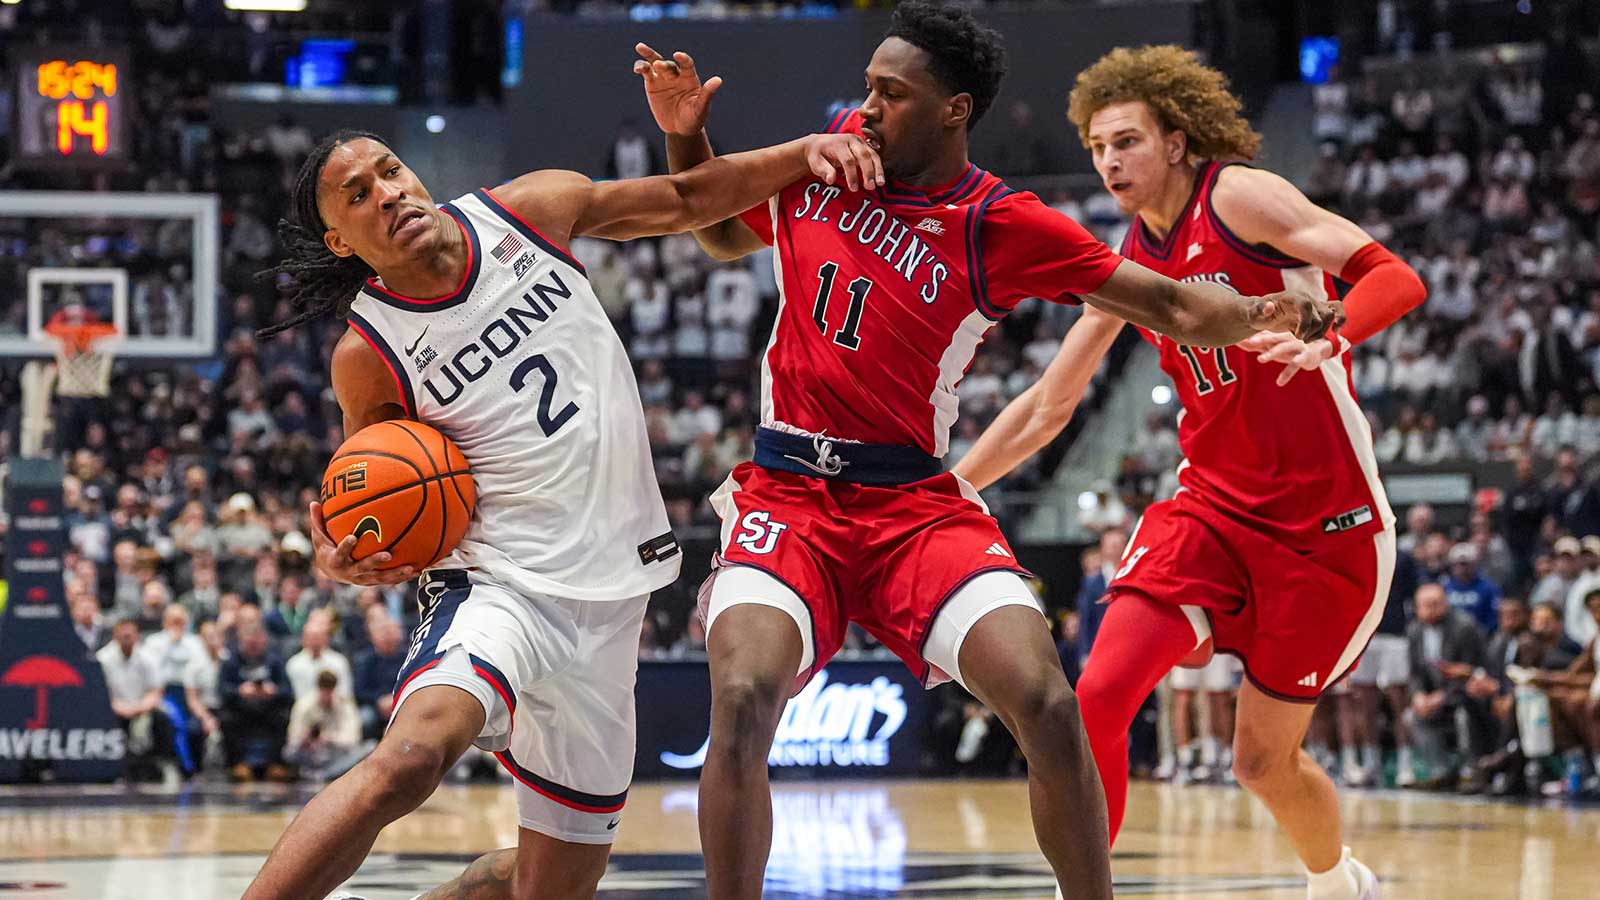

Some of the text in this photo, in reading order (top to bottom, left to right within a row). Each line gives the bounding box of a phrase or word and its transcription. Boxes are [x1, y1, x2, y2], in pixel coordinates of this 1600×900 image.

[57, 100, 109, 155] 14
[513, 251, 529, 271] BIG
[515, 252, 537, 278] EAST
[794, 182, 949, 304] ST. JOHN'S
[813, 261, 872, 351] 11
[416, 350, 439, 373] CHANGE
[420, 344, 433, 358] THE
[423, 270, 572, 406] UCONN
[509, 354, 580, 438] 2
